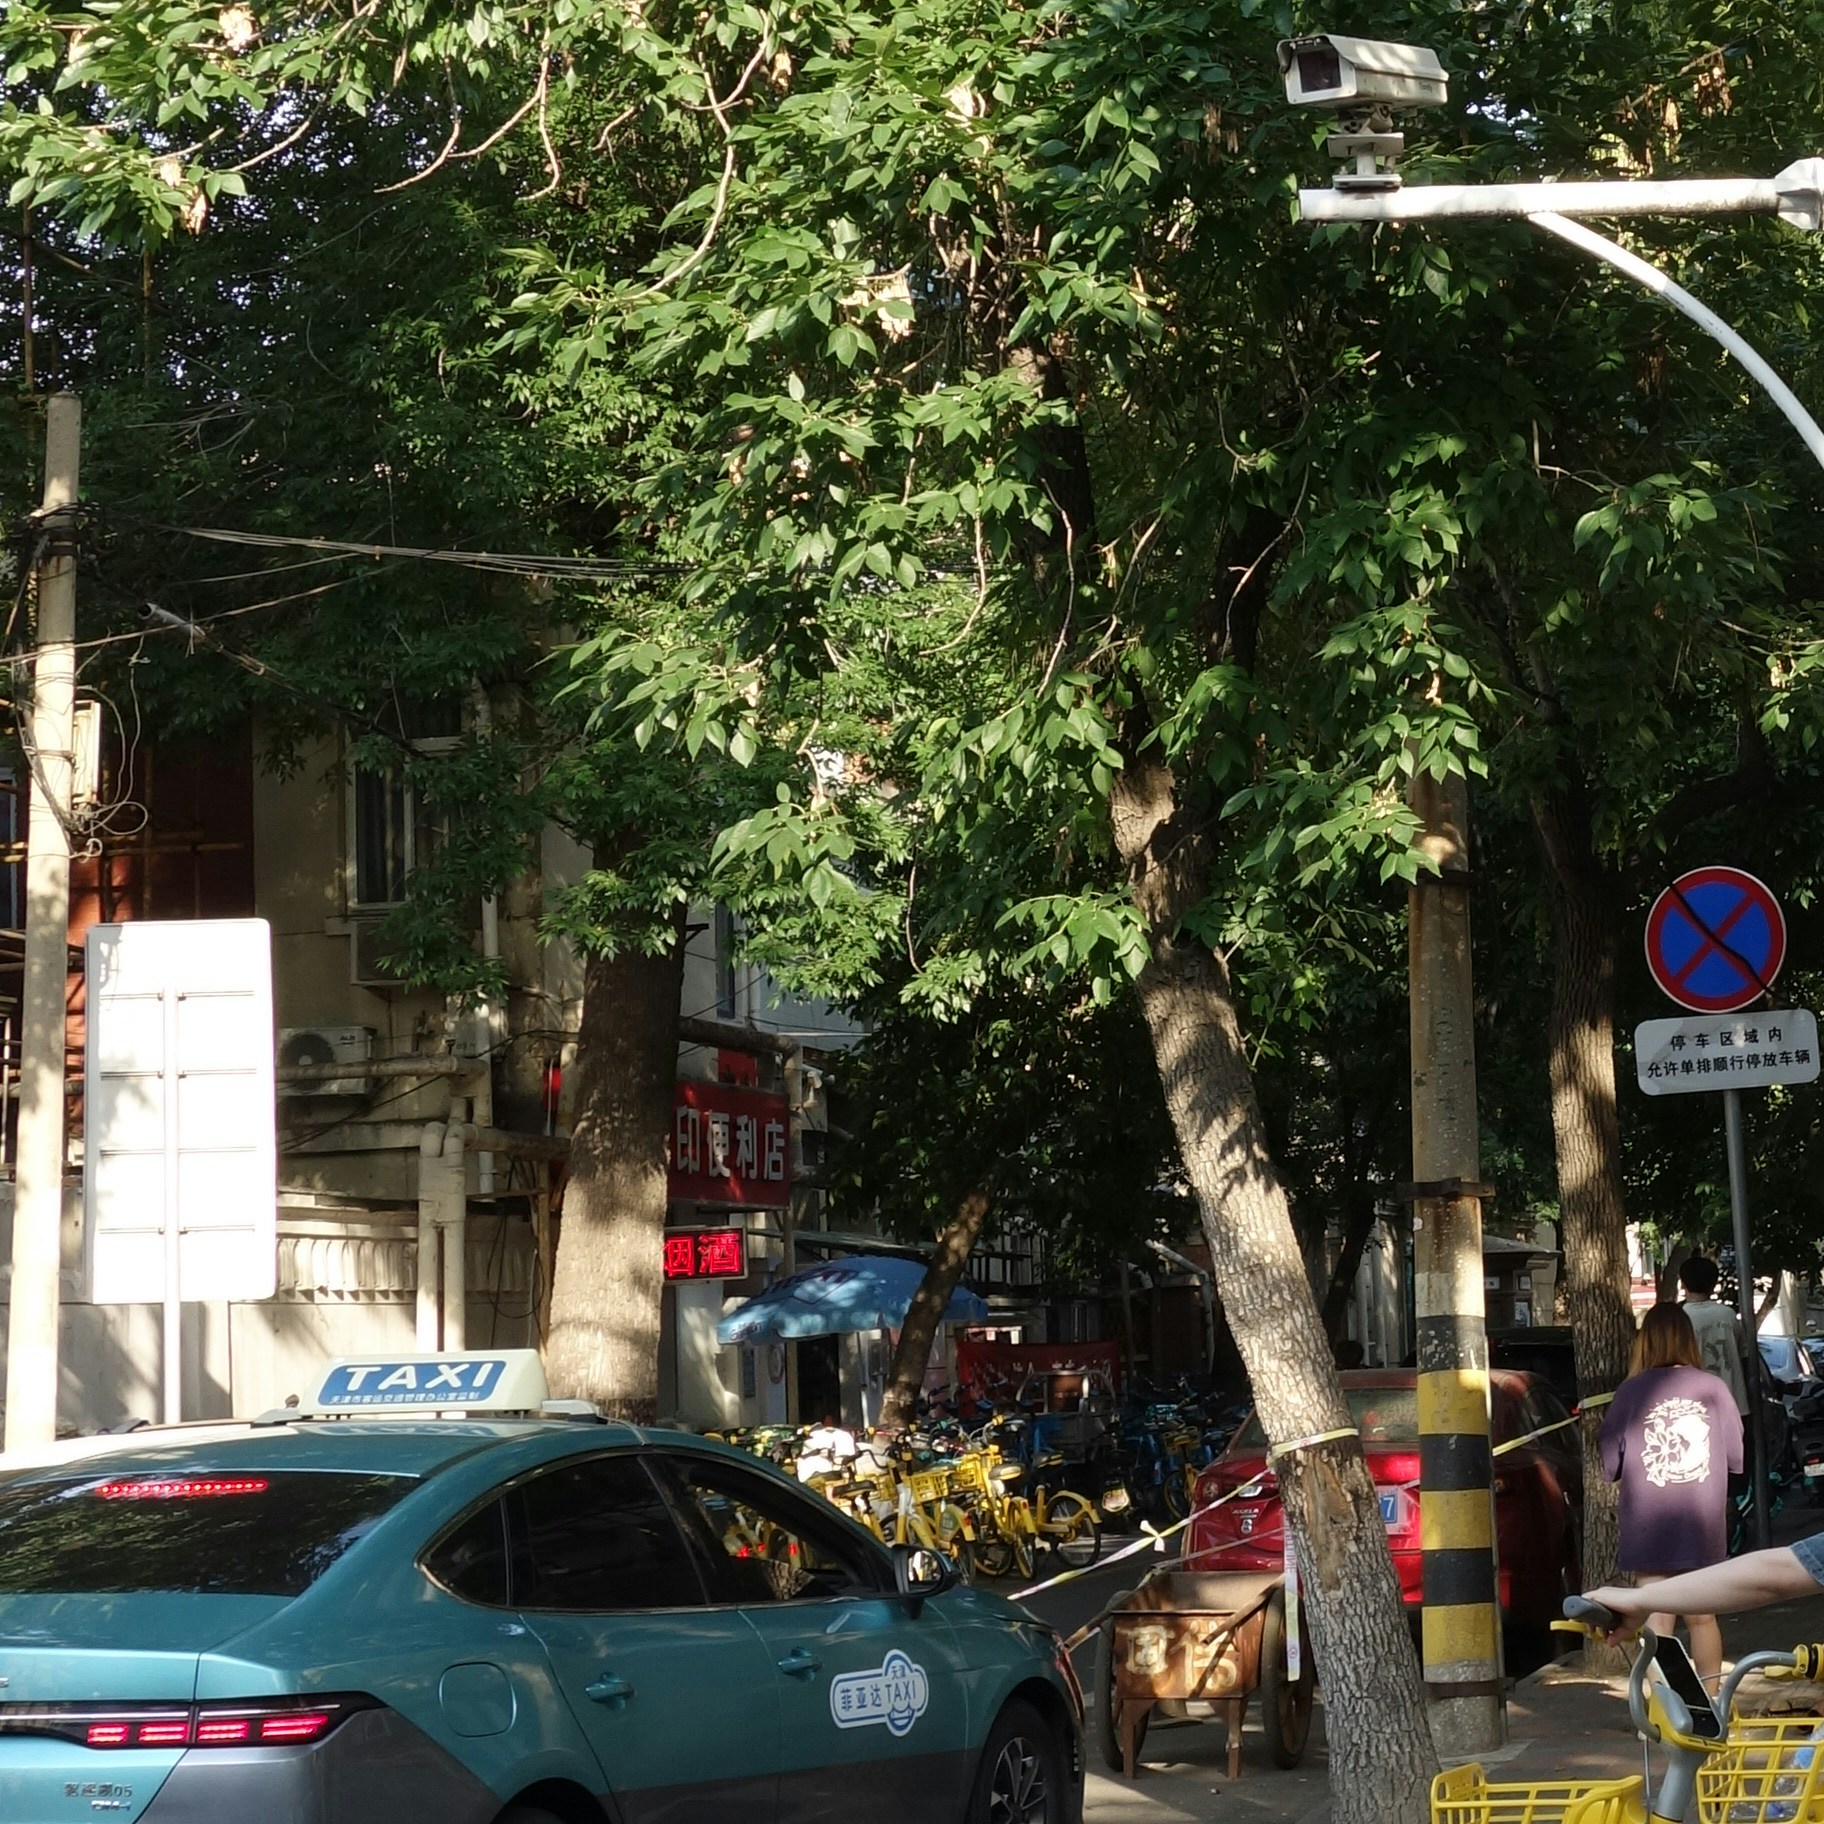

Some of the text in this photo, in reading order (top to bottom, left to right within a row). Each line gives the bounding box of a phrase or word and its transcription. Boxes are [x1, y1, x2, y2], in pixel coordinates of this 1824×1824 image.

[1670, 1026, 1783, 1051] 停车区域内
[1647, 1049, 1812, 1079] 允许单排顺行停放车辆
[676, 1105, 786, 1181] 印便利店
[345, 1362, 494, 1391] TAXI
[885, 1680, 916, 1704] TAXI
